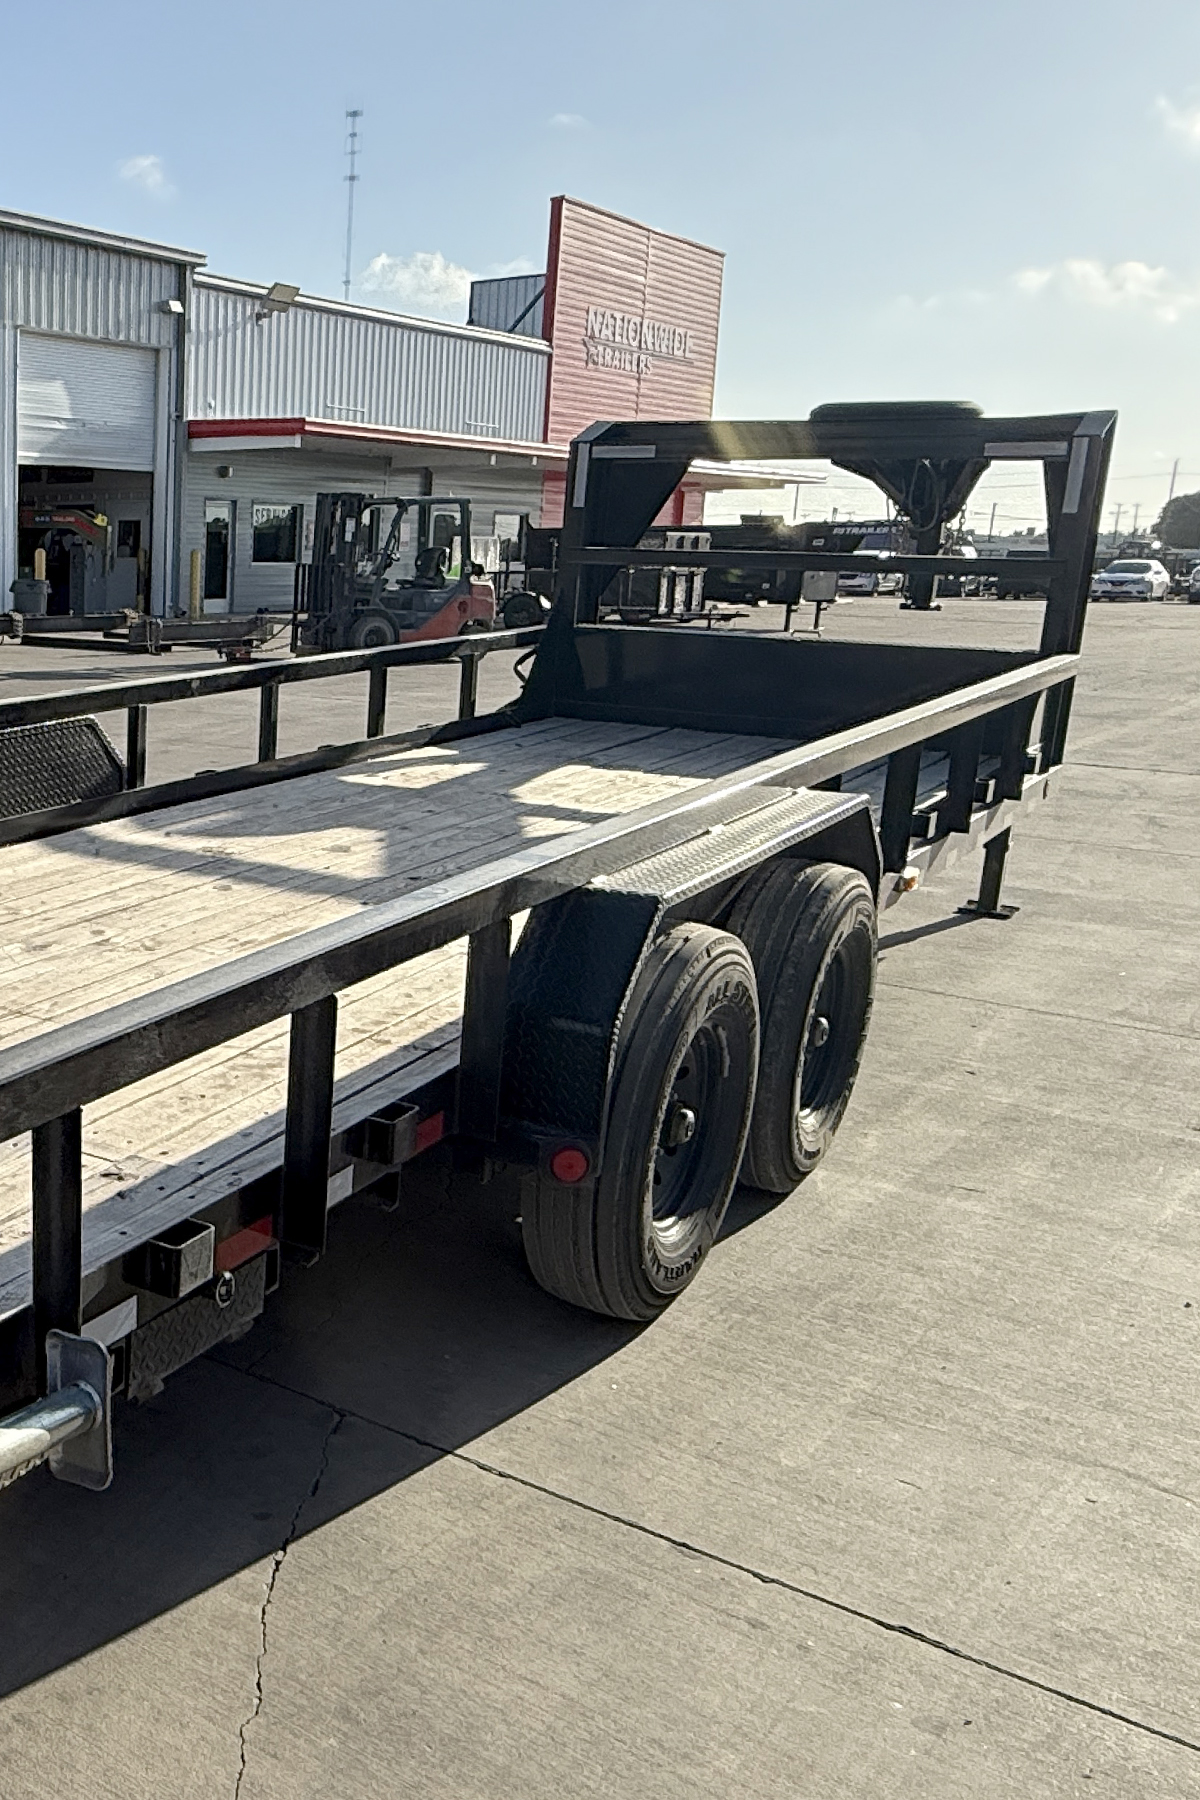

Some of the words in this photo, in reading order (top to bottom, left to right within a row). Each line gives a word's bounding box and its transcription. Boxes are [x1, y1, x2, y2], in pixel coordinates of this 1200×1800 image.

[586, 306, 693, 359] NATIONWIDE
[597, 345, 652, 375] TRAILERS
[704, 980, 731, 1014] ALL
